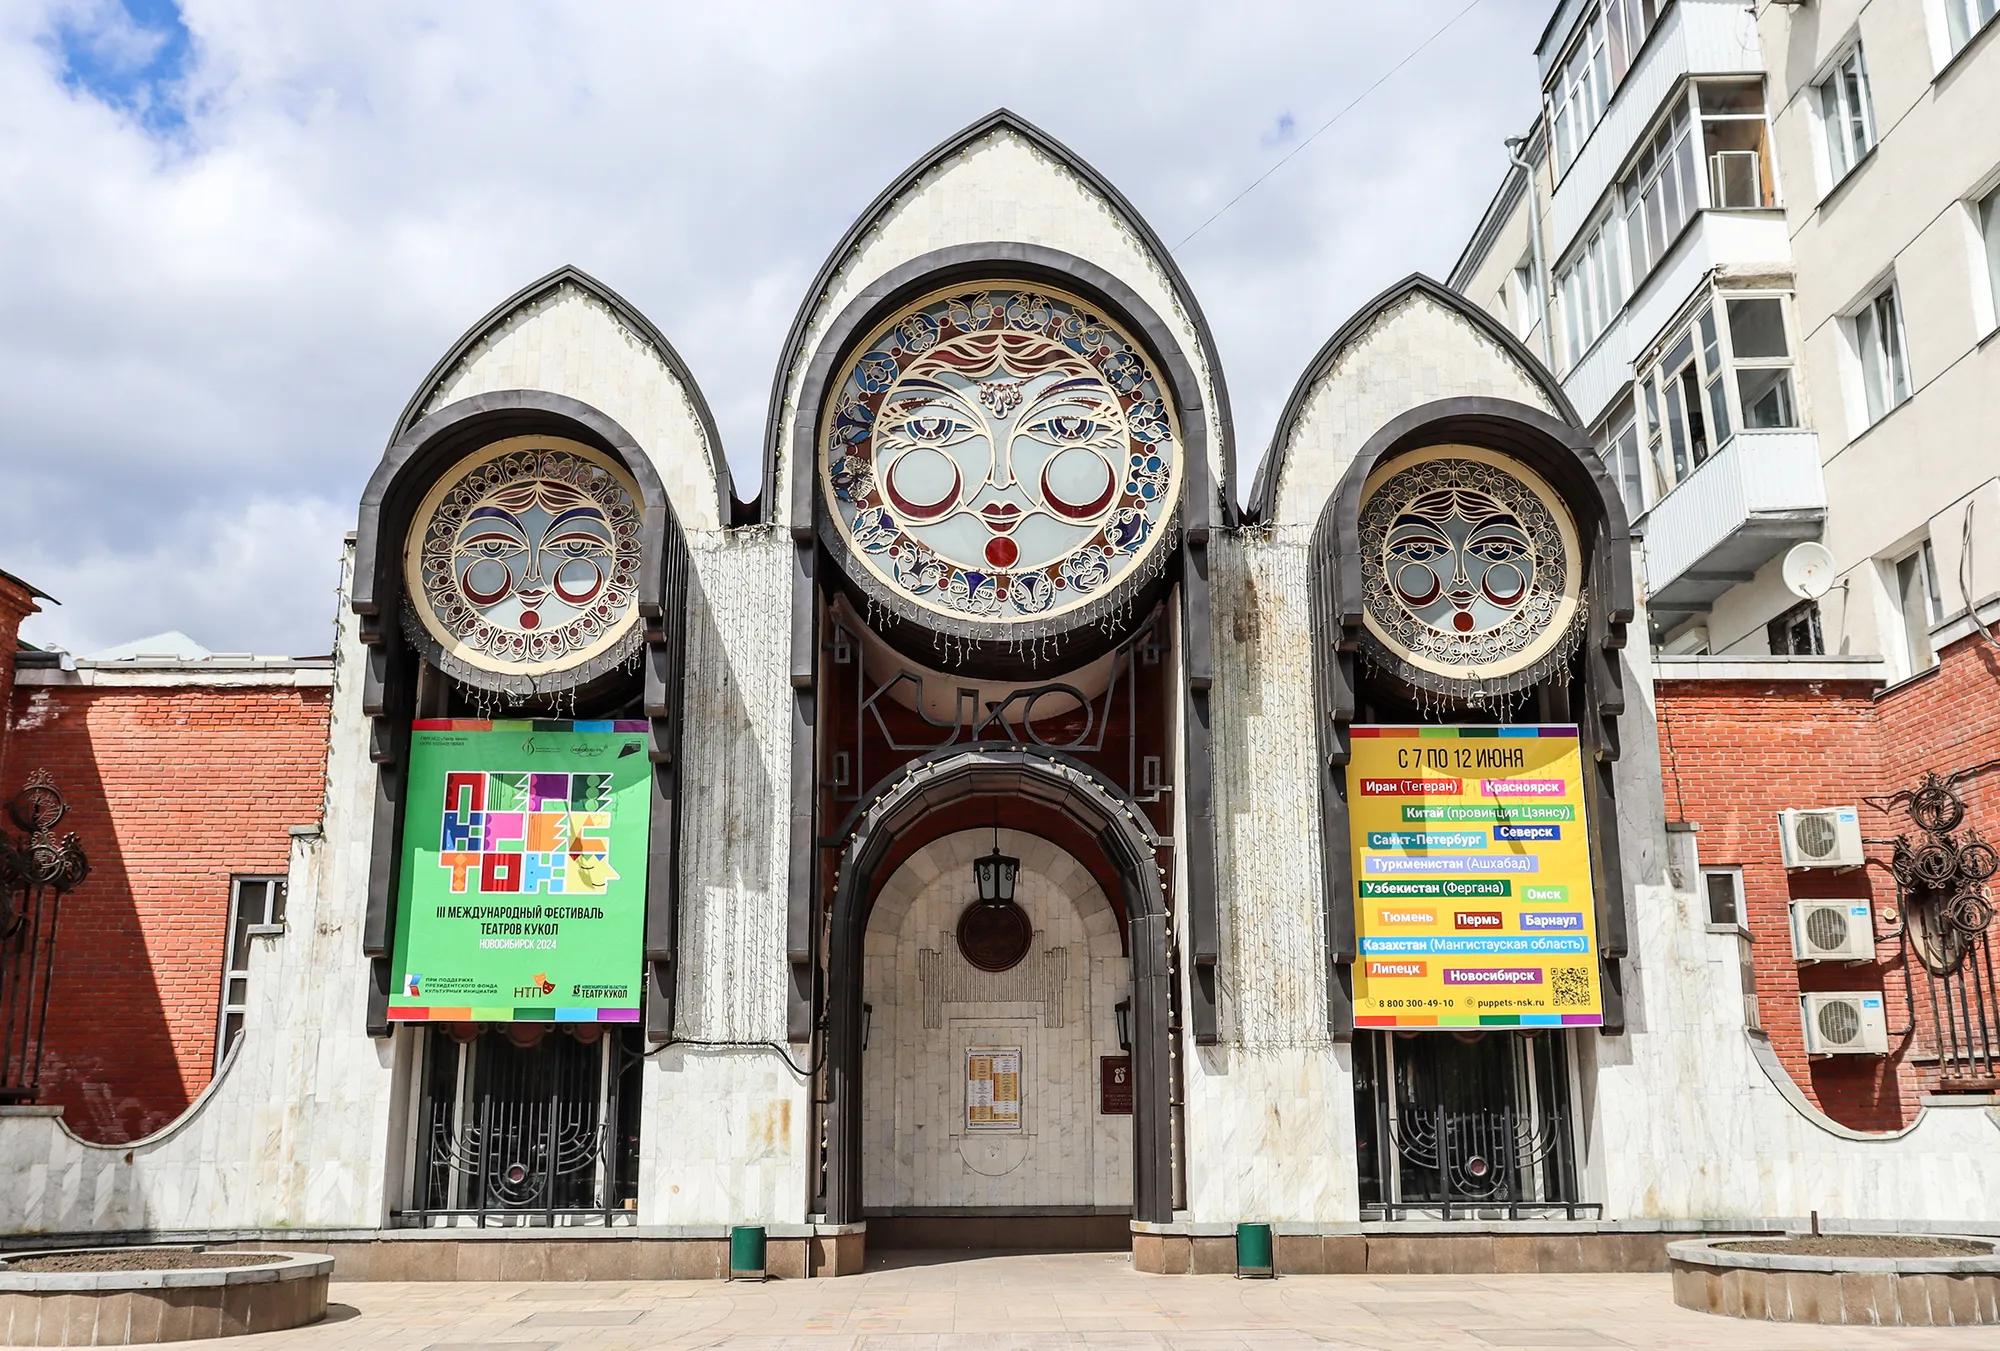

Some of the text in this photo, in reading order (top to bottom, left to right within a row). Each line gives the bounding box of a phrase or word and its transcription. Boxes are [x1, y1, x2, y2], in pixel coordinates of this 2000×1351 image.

[1398, 748, 1524, 769] С 7 ПО 12 ИЮНЯ
[1366, 780, 1458, 794] Иран (Тегеран)
[1486, 781, 1560, 794] Красноярск
[1406, 806, 1570, 820] Китай (провинция Цзянсу)
[1500, 826, 1553, 839] Северск
[1373, 834, 1482, 847] Санкт-Петербург
[1373, 857, 1530, 872] Туркменистан (Ашхабад)
[1366, 880, 1504, 895] Узбекистан (Фергана)
[1527, 889, 1561, 900] Омск
[436, 905, 604, 919] III МЕЖДУНАРОДНЫЙ ФЕСТИВАЛЬ
[1382, 911, 1433, 922] Тюмень
[1457, 913, 1500, 927] Пермь
[1525, 915, 1577, 928] Барнаул
[481, 923, 559, 935] ТЕАТРОВ КУКОЛ
[480, 939, 557, 949] НОВОСИБИРСК 2024
[1363, 937, 1585, 952] Казахстан (Мангистауская область)
[1372, 963, 1420, 975] Липецк
[1450, 970, 1536, 983] Новосибирск
[514, 987, 542, 998] НТП
[582, 990, 628, 998] ТЕАТР КУКОЛ
[1379, 1000, 1454, 1008] 8 800 300-49-10
[1478, 999, 1545, 1008] puppets-nsk.ru
